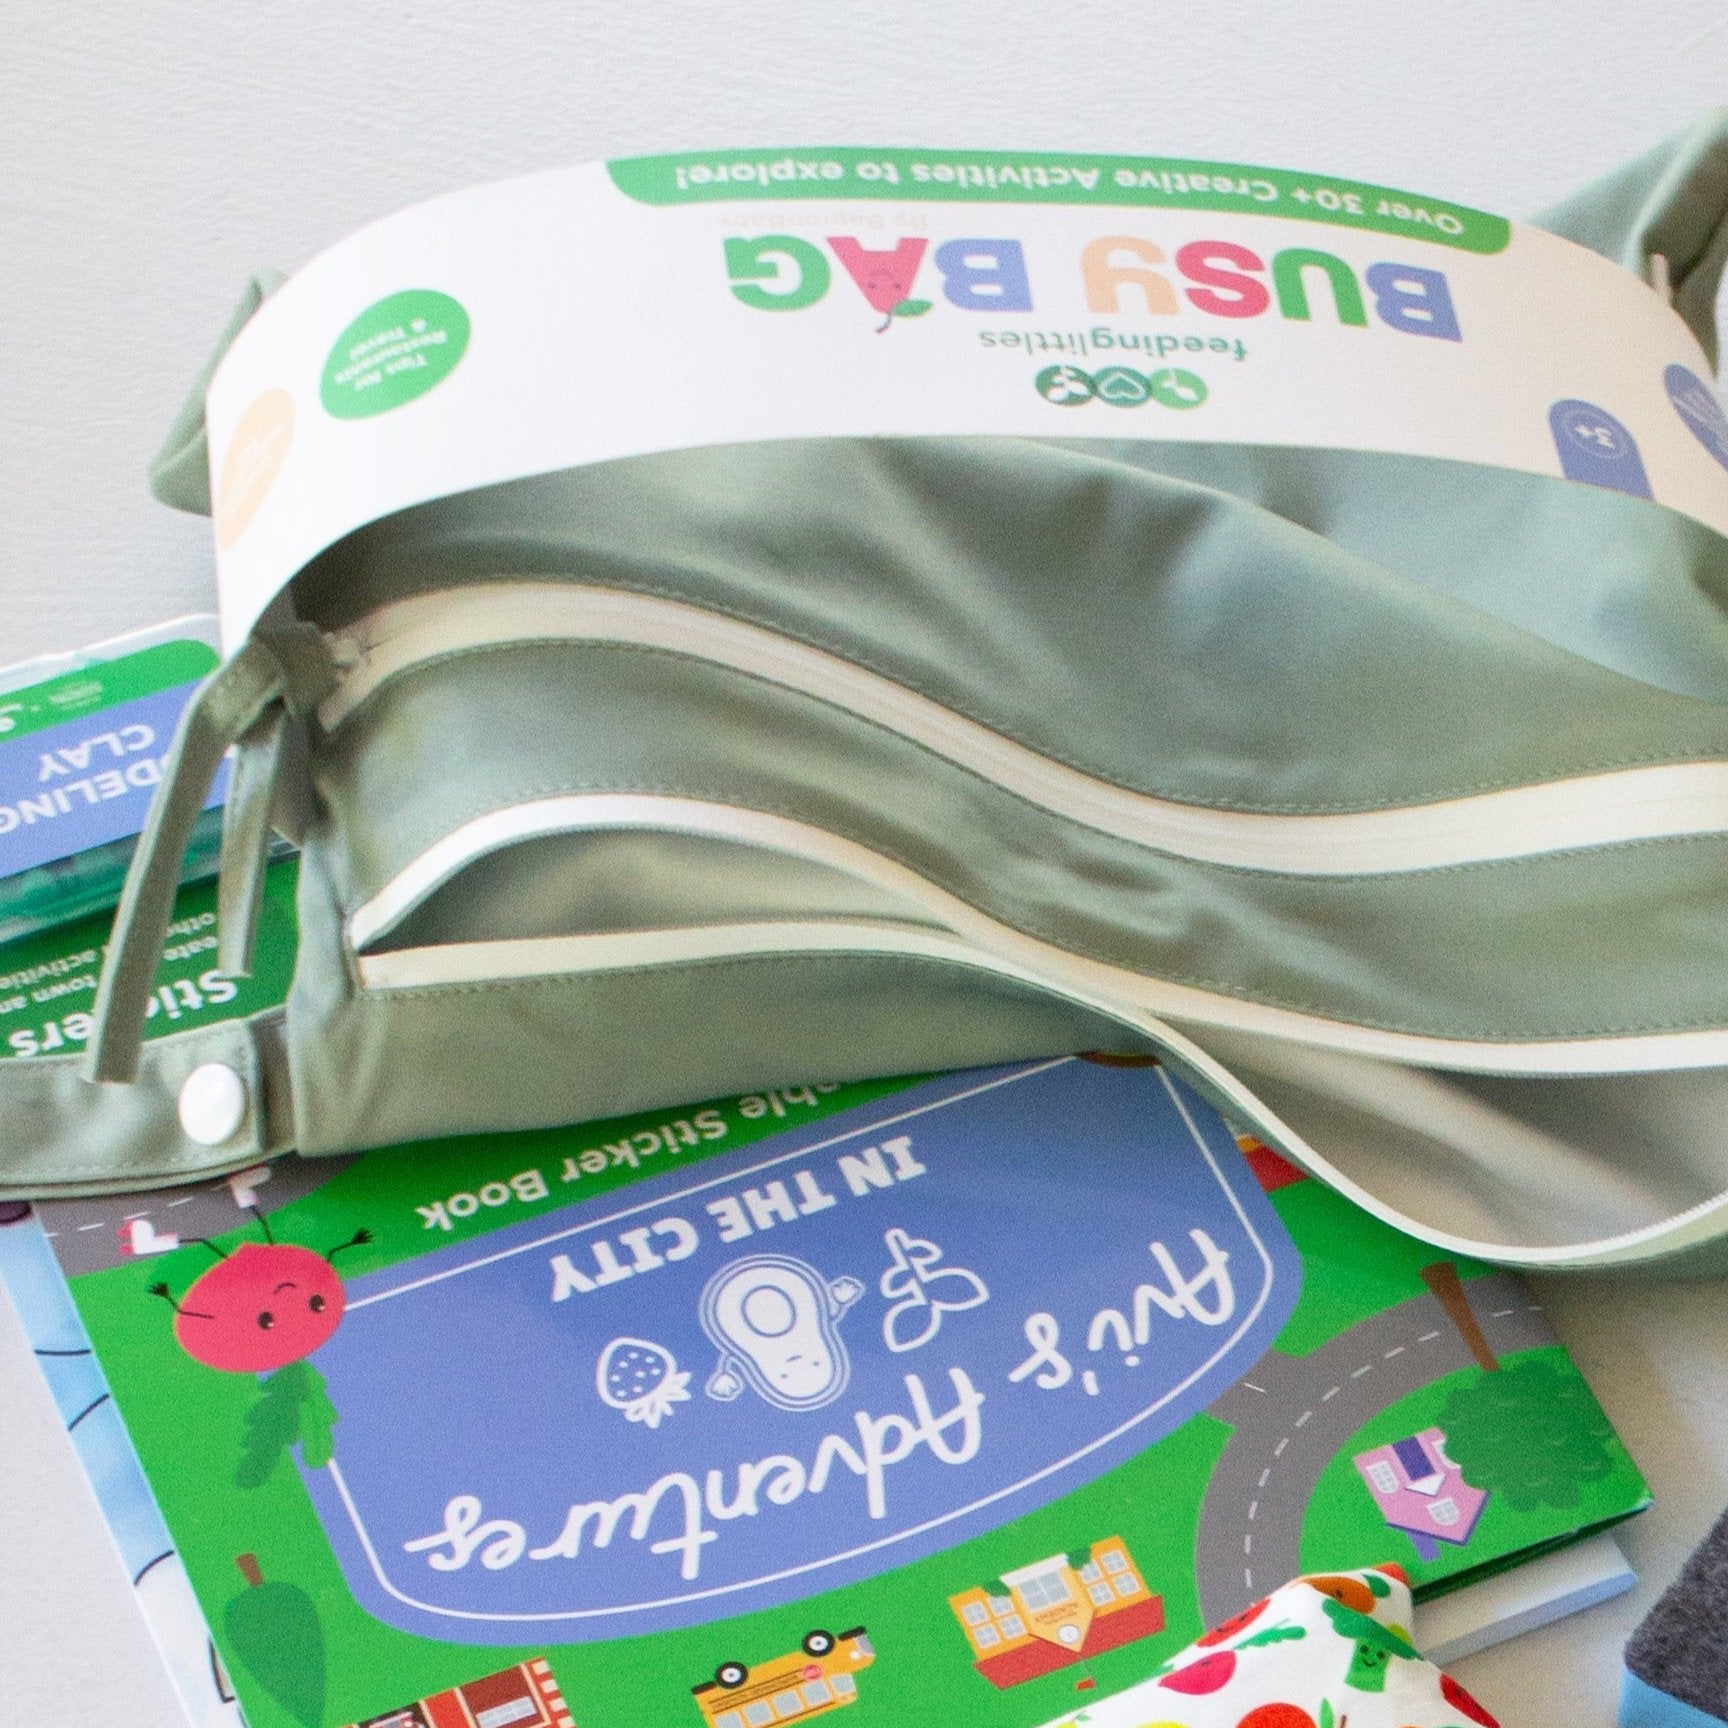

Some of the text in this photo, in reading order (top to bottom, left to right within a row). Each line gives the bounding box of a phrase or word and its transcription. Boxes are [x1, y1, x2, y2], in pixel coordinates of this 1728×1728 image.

[675, 158, 1464, 236] Over 30+ Creative Activities to explore!
[722, 235, 1462, 343] BUSY BAG
[978, 328, 1247, 362] feedinglittles
[37, 722, 155, 783] CLAY
[0, 949, 96, 991] activitie
[561, 1108, 727, 1185] Sticker
[414, 1168, 550, 1233] Book
[548, 1134, 926, 1302] IN THE CITY
[403, 1229, 1235, 1580] Avi's Adventures
